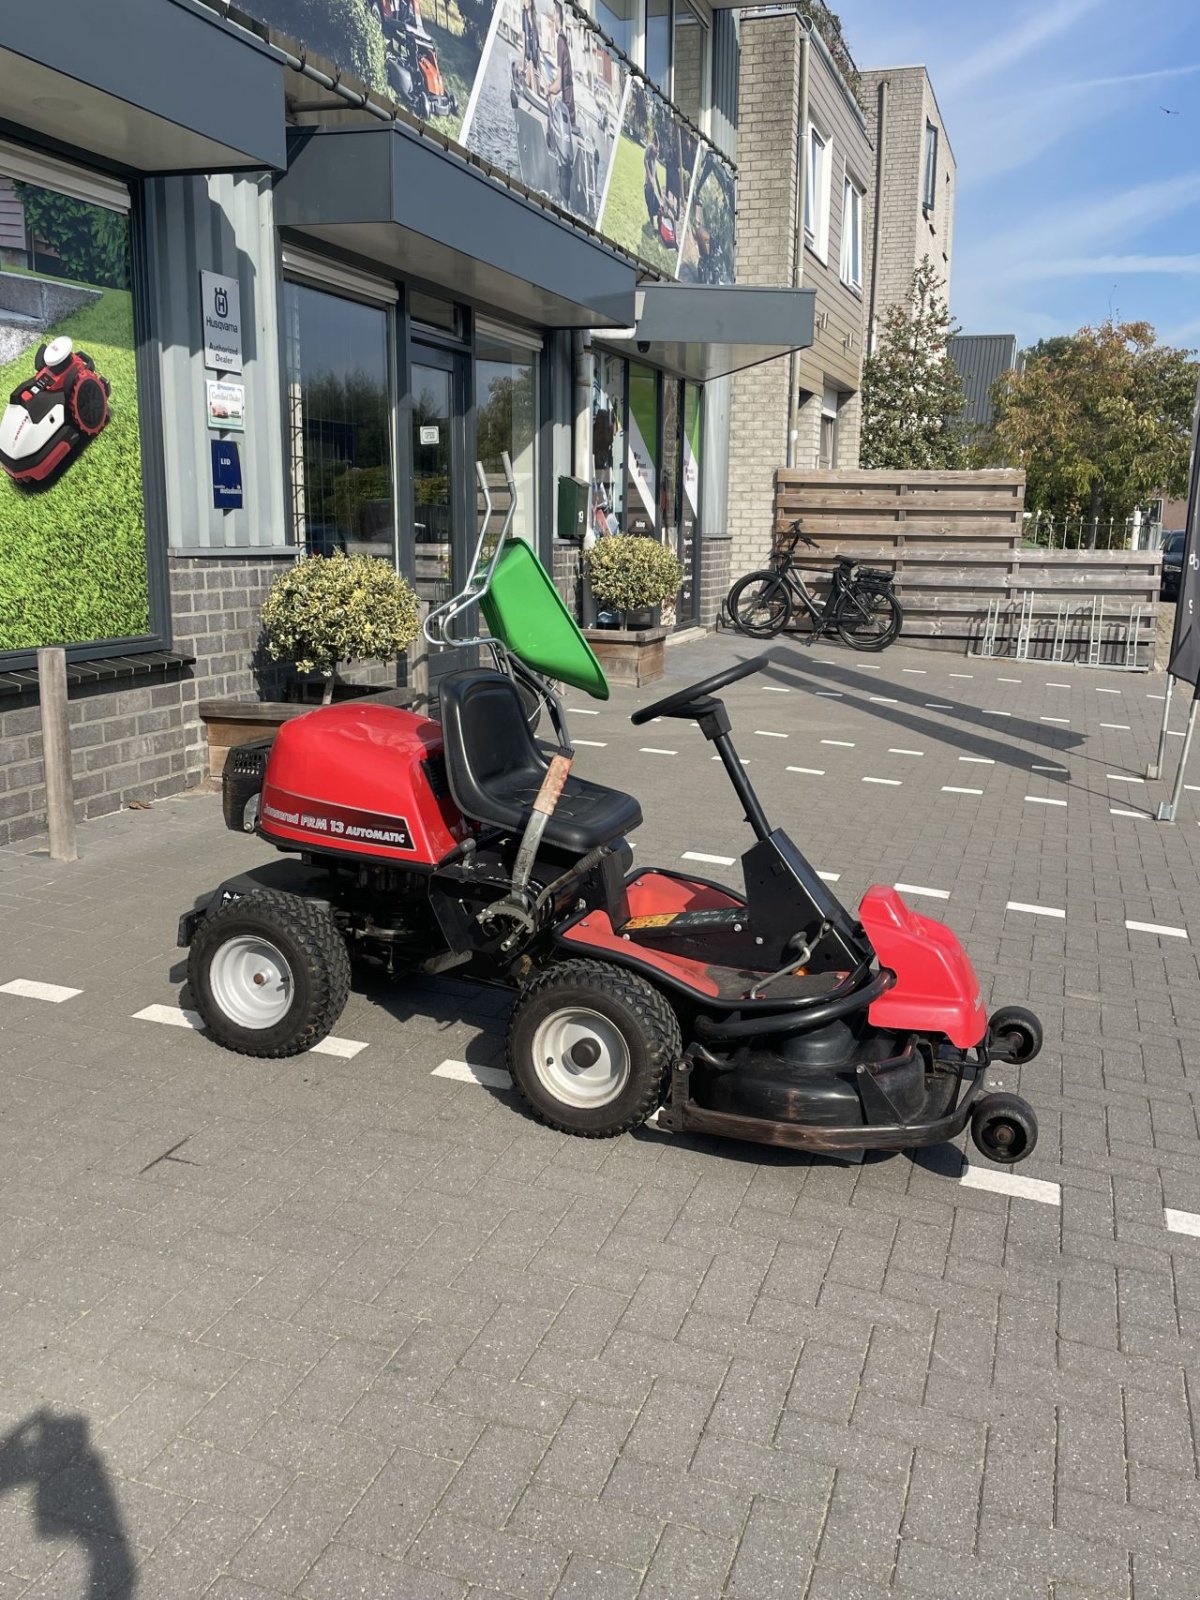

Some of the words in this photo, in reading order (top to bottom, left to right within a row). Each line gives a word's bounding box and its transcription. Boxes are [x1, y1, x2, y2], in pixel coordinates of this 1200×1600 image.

[206, 316, 238, 333] Husqvarna
[209, 342, 239, 355] Authorized
[215, 353, 233, 364] Dealer
[220, 457, 231, 466] LID
[330, 819, 344, 833] 13
[345, 825, 405, 843] AUTOMATIC
